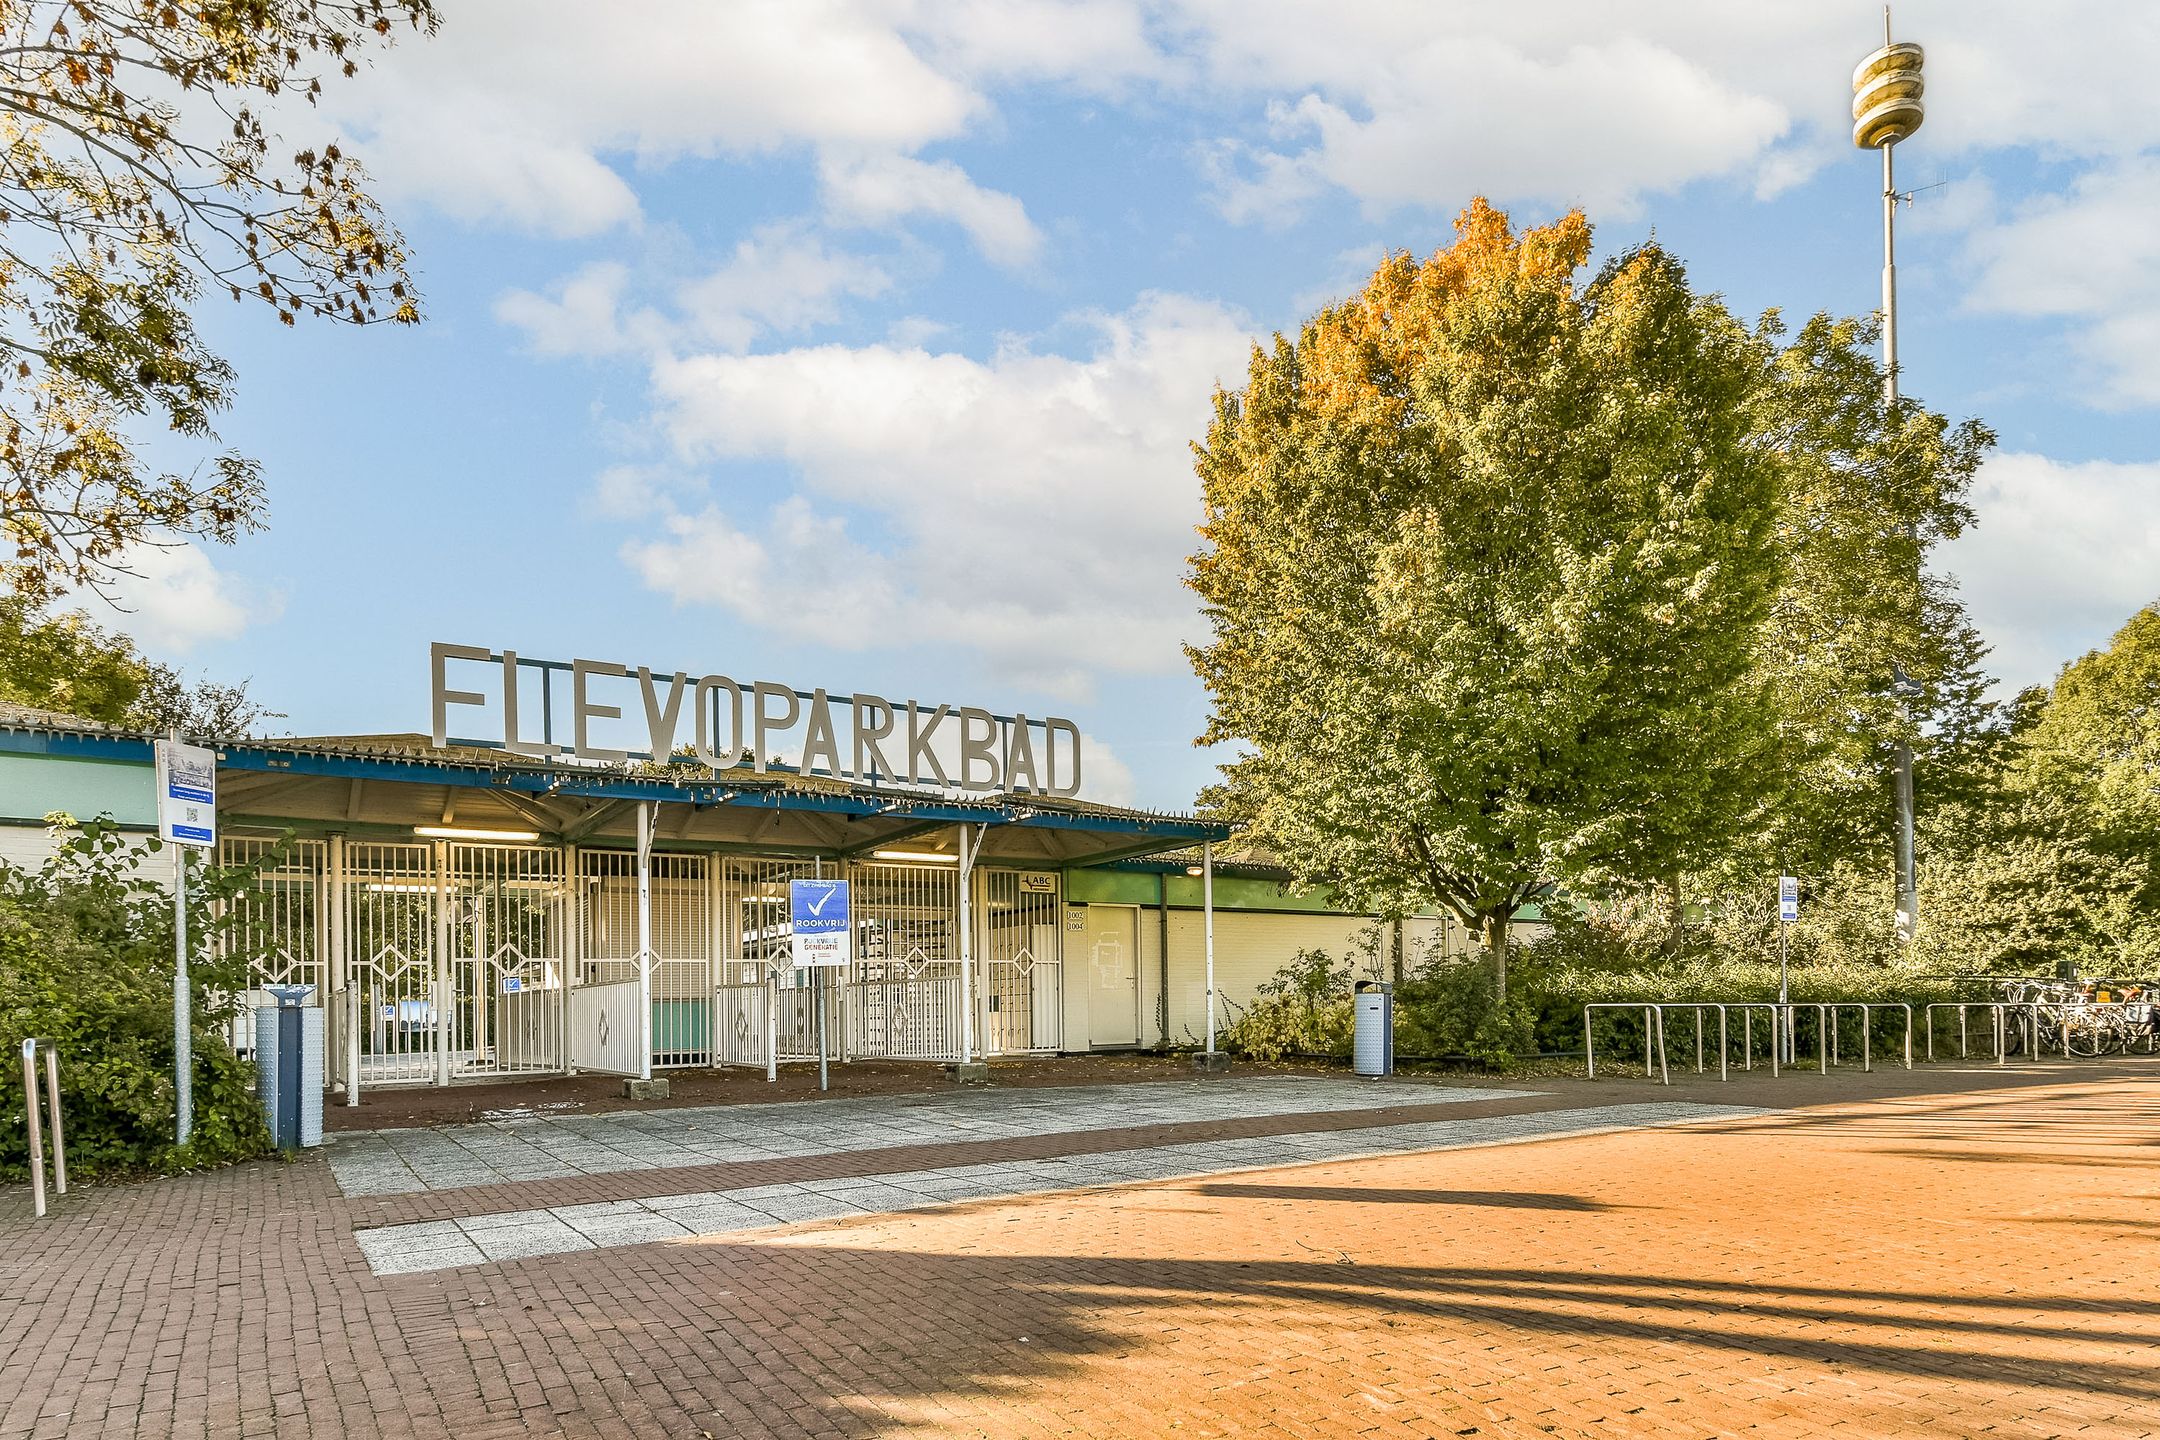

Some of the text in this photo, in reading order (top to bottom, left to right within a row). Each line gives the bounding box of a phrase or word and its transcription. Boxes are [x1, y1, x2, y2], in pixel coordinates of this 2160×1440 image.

[430, 641, 1081, 799] FLEVOPARKBAD
[1033, 876, 1050, 884] ABC
[1068, 911, 1083, 919] 1002
[796, 919, 845, 927] ROOKVRIJ
[1068, 922, 1083, 930] 1004
